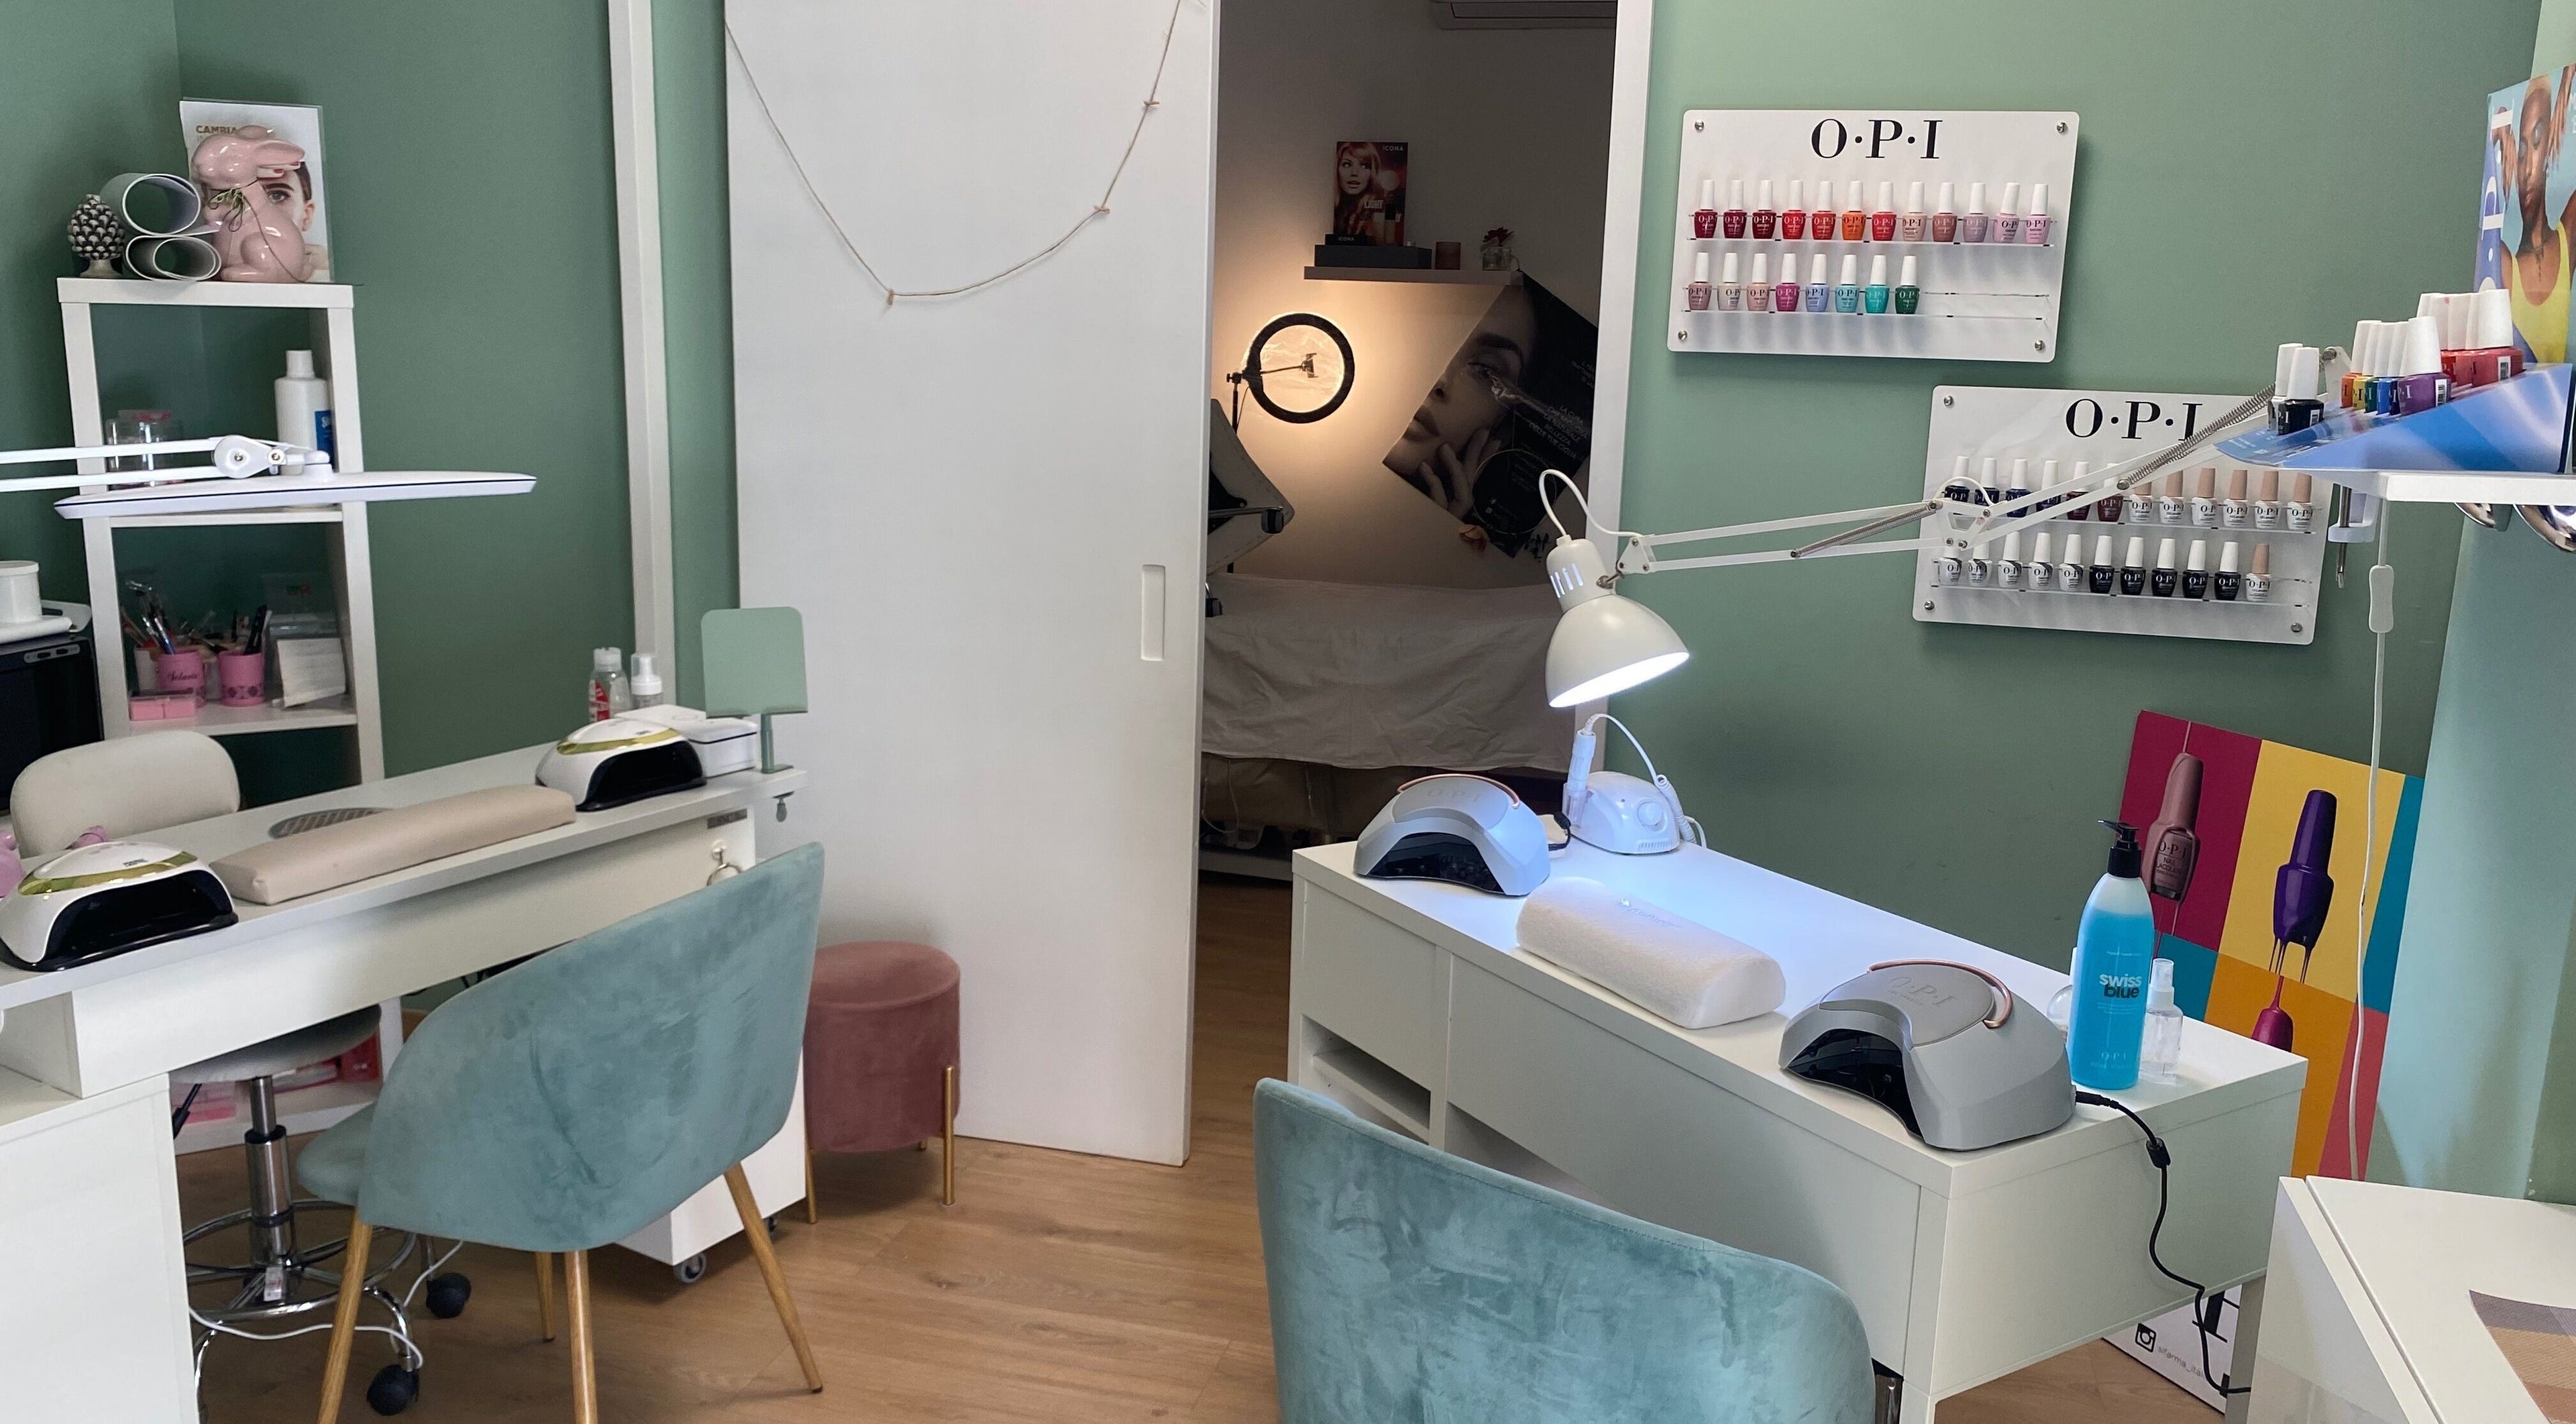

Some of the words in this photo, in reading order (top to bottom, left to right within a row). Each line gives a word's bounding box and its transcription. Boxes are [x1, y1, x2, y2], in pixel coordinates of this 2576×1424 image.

[1811, 118, 1943, 159] O·P·I
[2066, 398, 2203, 441] O·P·I
[2099, 973, 2142, 987] swiss
[2104, 984, 2140, 999] blue
